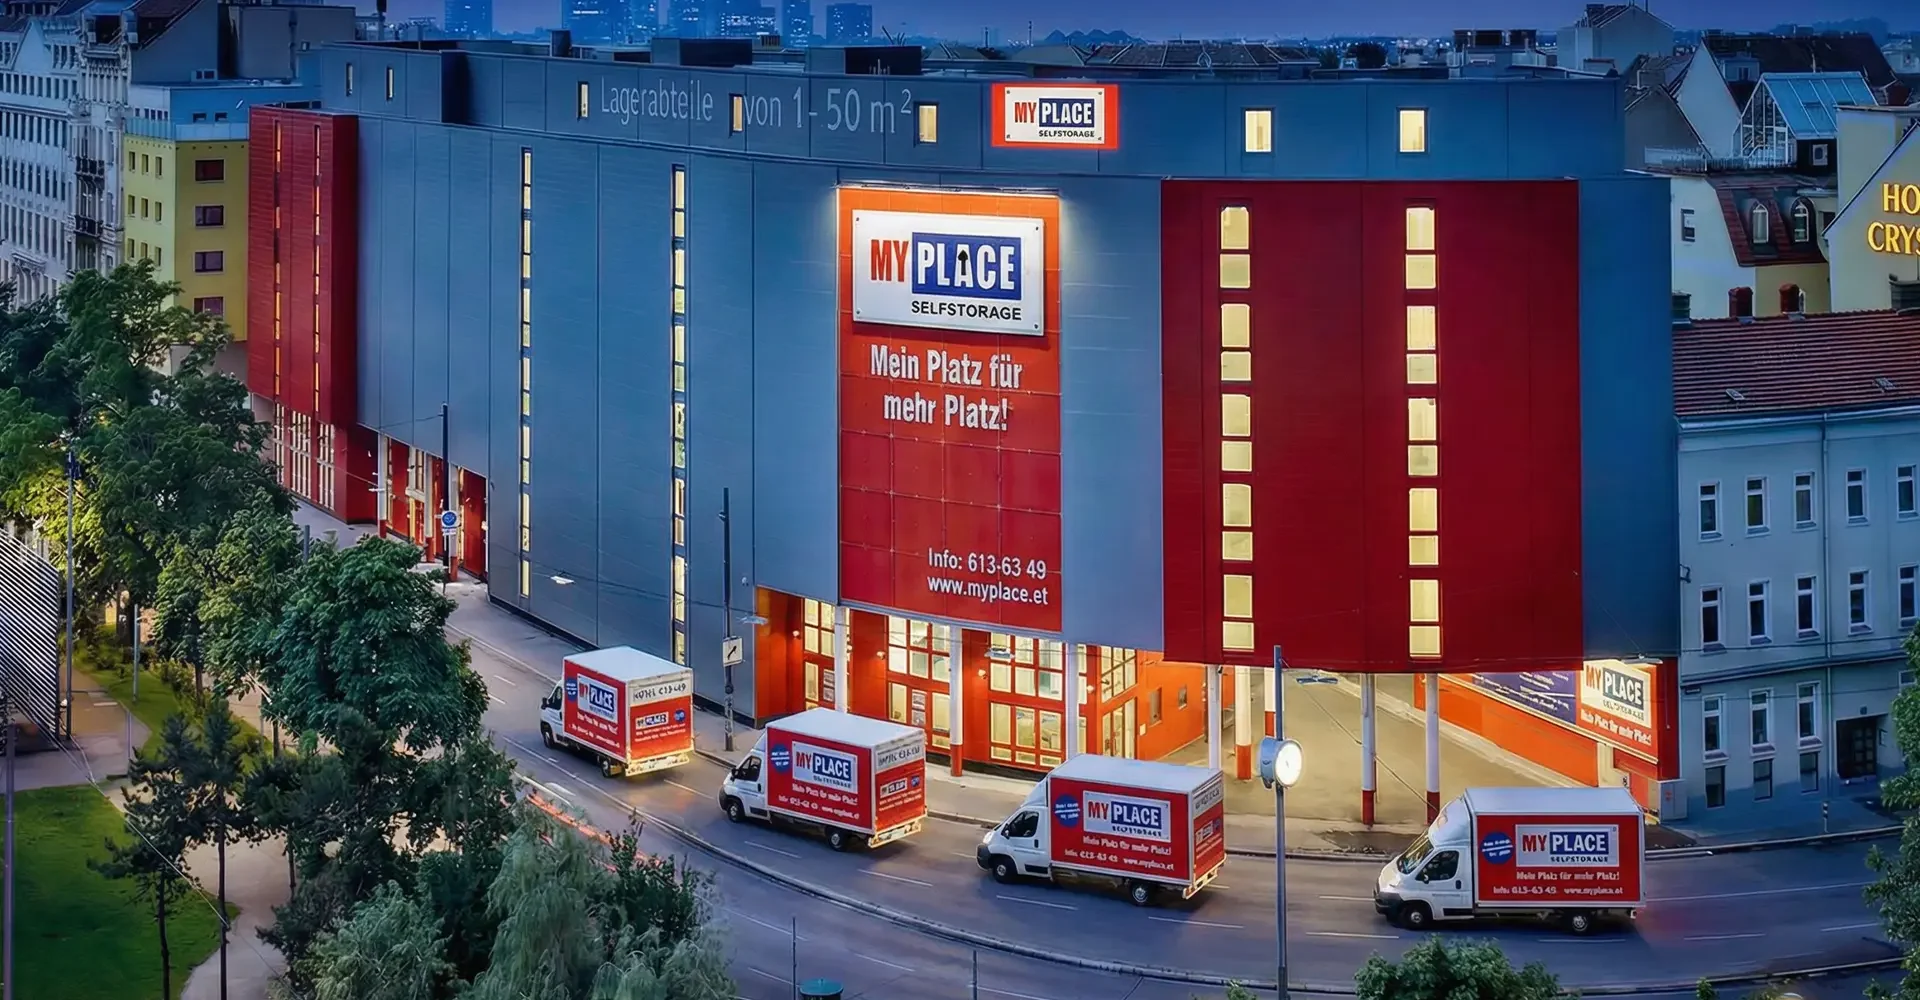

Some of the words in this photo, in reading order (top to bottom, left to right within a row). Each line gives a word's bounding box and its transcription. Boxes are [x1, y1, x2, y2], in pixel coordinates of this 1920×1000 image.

[601, 77, 714, 125] Lagerabteile
[743, 95, 782, 128] von
[1014, 102, 1037, 123] MY
[1041, 102, 1092, 124] PLACE
[1038, 129, 1095, 138] SELFSTORAGE
[870, 239, 909, 282] MY
[916, 241, 1015, 290] PLACE
[911, 300, 1022, 321] SELFSTORAGE
[870, 344, 920, 380] Mein
[926, 349, 983, 386] Platz
[989, 353, 1023, 389] für
[883, 391, 937, 424] mehr
[944, 393, 1008, 431] Platz!
[927, 547, 963, 570] Info:
[967, 552, 1021, 577] 613-63
[1026, 559, 1047, 580] 49
[1604, 671, 1643, 706] PLACE
[795, 751, 812, 770] MY
[814, 755, 850, 779] PLACE
[1088, 801, 1109, 820] MY
[1113, 804, 1160, 826] PLACE
[1522, 834, 1548, 852] MY
[1552, 834, 1607, 852] PLACE
